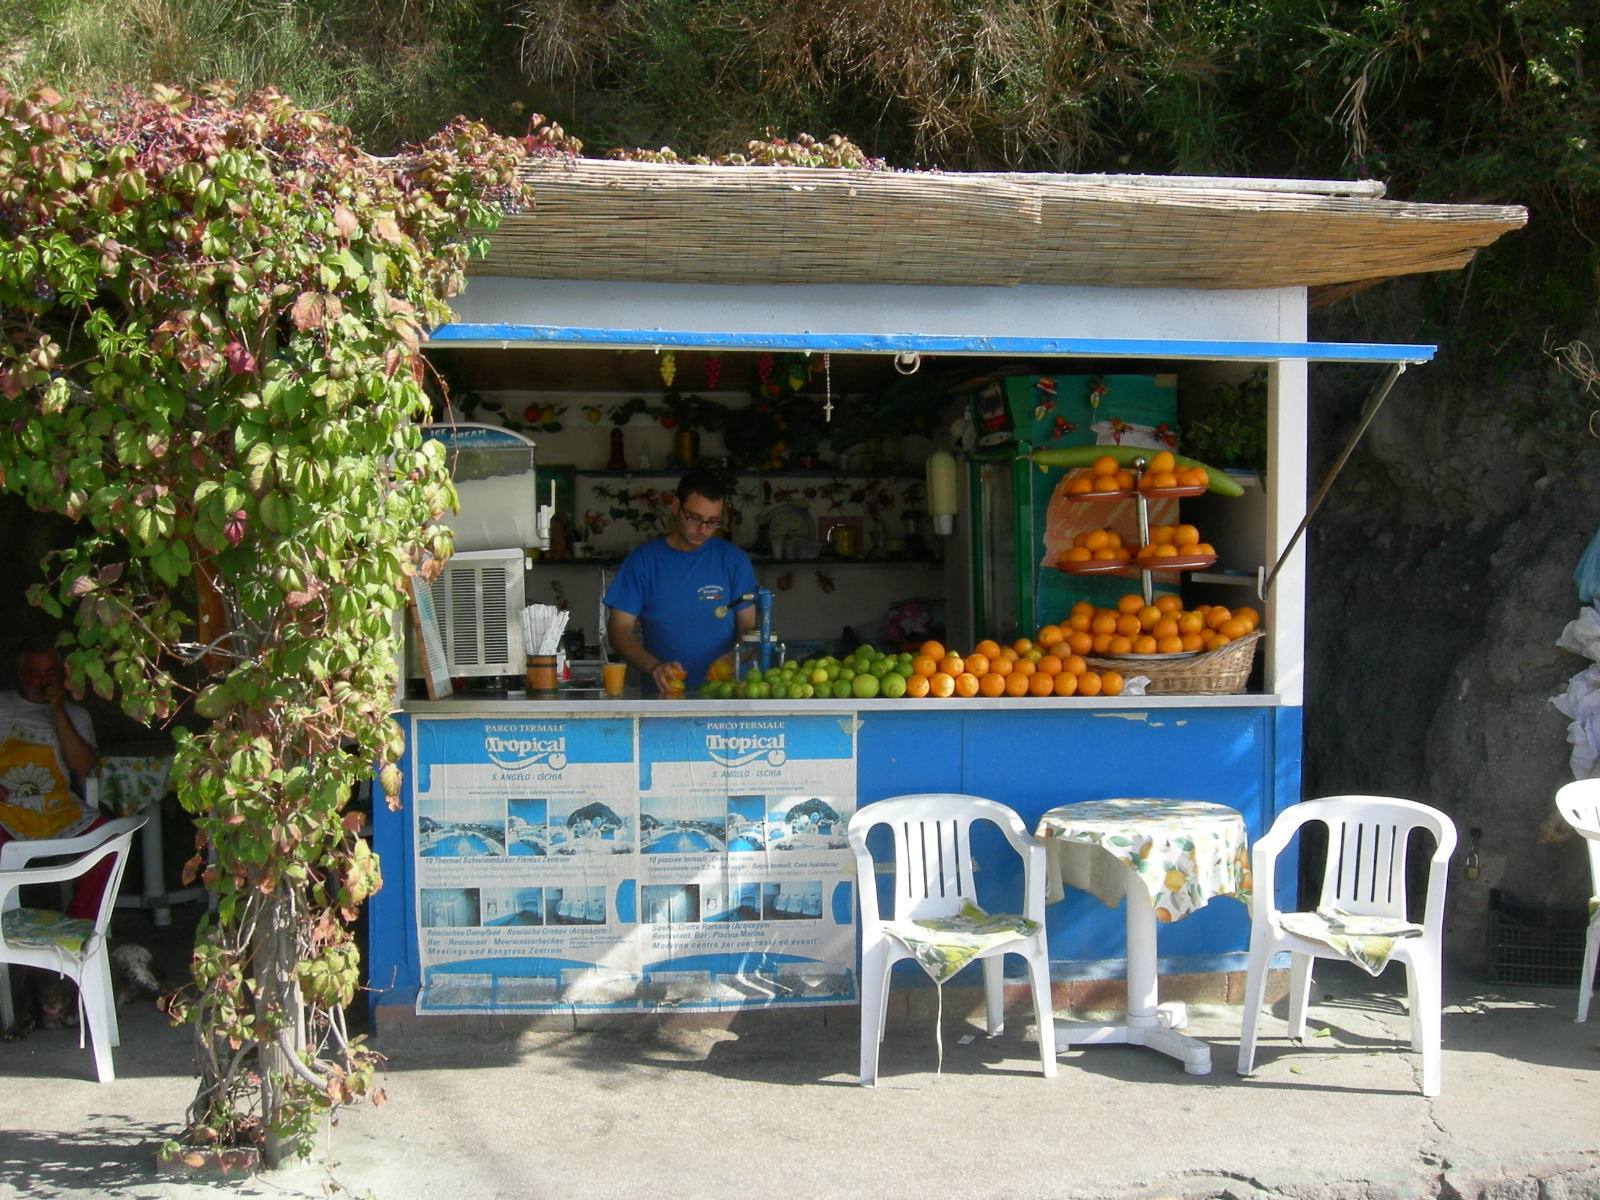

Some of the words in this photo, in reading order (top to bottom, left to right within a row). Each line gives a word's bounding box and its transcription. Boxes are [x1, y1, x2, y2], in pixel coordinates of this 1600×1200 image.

[430, 428, 446, 437] ICE
[485, 724, 518, 733] PARCO
[519, 724, 566, 733] TERMALE
[706, 722, 738, 730] PARCO
[739, 721, 785, 729] TERMALE
[485, 737, 566, 757] Tropical
[705, 733, 785, 754] Tropical
[500, 773, 531, 781] ANGELO
[537, 772, 563, 781] ISCHIA
[720, 770, 750, 778] ANGELO
[756, 769, 782, 777] ISCHIA
[542, 855, 571, 863] Zentrum
[648, 856, 657, 864] 10
[691, 941, 720, 949] centro
[721, 941, 734, 949] per
[427, 947, 467, 956] Meetings
[469, 947, 485, 955] und
[487, 946, 526, 956] Kongress
[527, 946, 563, 955] Zentrum
